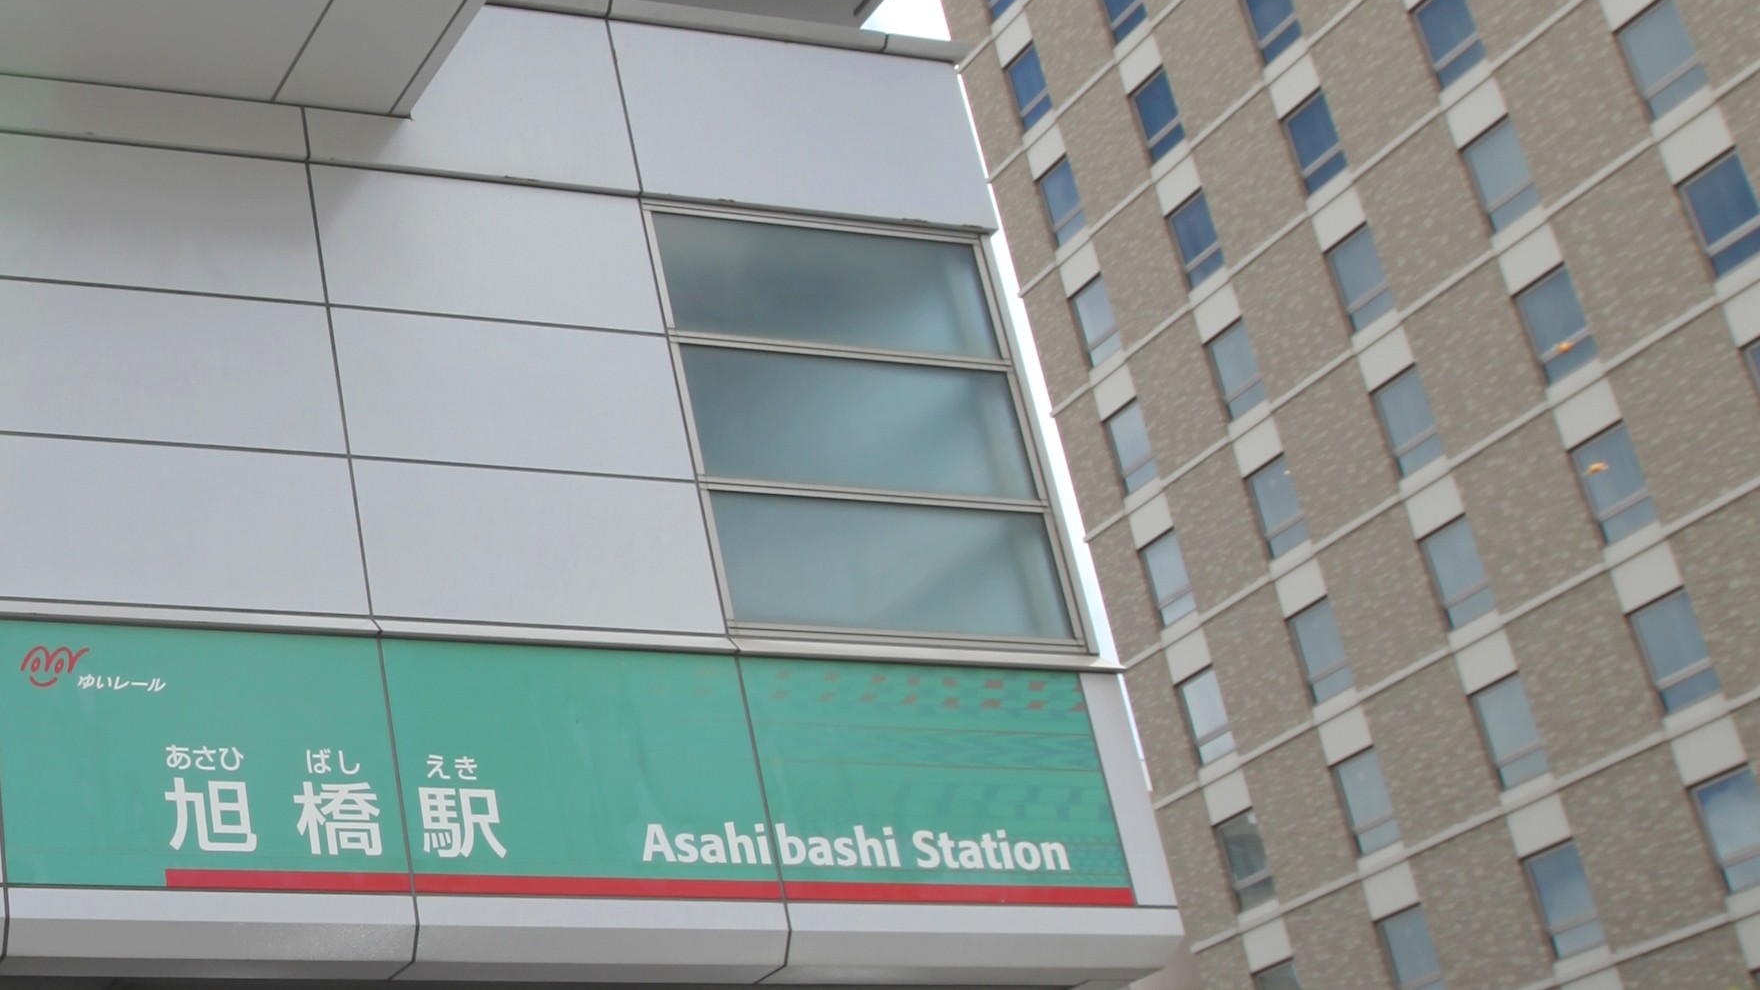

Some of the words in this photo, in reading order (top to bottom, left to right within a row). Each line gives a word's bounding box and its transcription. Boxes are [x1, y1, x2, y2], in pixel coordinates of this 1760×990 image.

[77, 673, 167, 692] ゆいレール
[165, 744, 244, 772] あさひ
[305, 748, 361, 775] ばし
[426, 754, 478, 781] えき
[642, 821, 902, 868] Asahibashi
[912, 829, 1071, 871] Station
